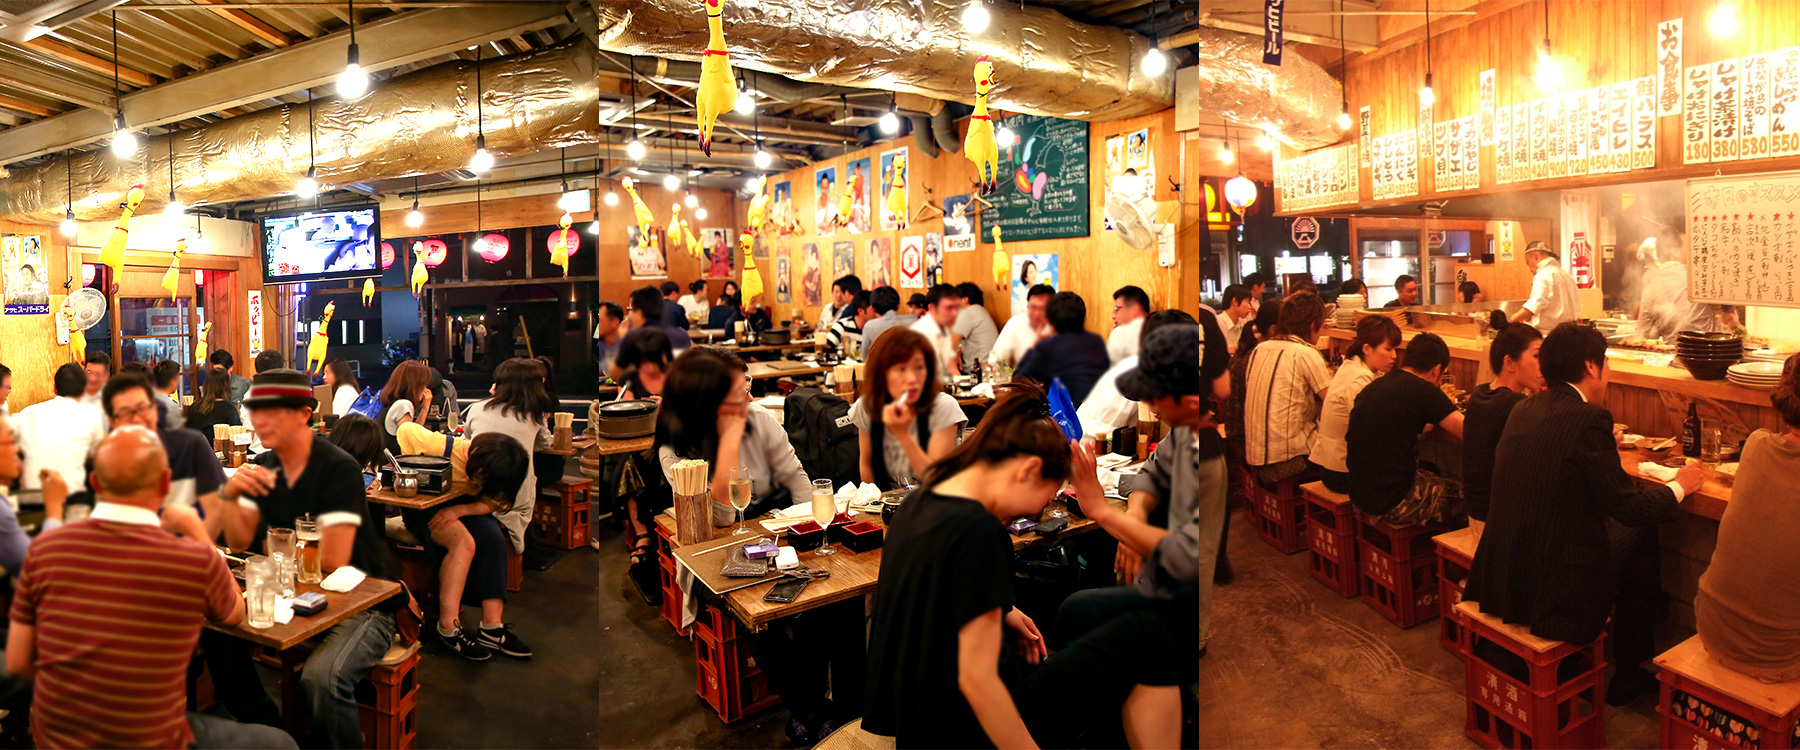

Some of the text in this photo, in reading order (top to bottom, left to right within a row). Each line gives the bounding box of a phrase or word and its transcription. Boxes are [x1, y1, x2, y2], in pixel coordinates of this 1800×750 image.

[1660, 22, 1681, 113] お食事
[1686, 69, 1709, 142] しゃけおにぎり
[1713, 63, 1737, 138] しゃけ茶漬け
[1772, 66, 1786, 133] きしめん
[1611, 88, 1629, 150] エイヒレ
[1636, 77, 1655, 149] 鮭ハラス
[1450, 121, 1461, 173] サザエ
[1686, 142, 1709, 161] 180
[1713, 139, 1737, 158] 380
[1742, 136, 1768, 156] 580
[1772, 132, 1800, 153] 550
[1384, 137, 1393, 182] ししとう
[1395, 136, 1405, 182] にんにく
[1406, 133, 1416, 180] エリンギ
[1568, 158, 1587, 174] 720
[1589, 153, 1608, 169] 450
[1610, 152, 1629, 169] 430
[1633, 150, 1654, 167] 500
[1497, 167, 1512, 182] 620
[1514, 165, 1529, 180] 580
[1532, 163, 1547, 178] 420
[1549, 161, 1566, 176] 900
[1450, 175, 1463, 188] 230
[1464, 173, 1478, 186] 250
[251, 294, 260, 335] ホッピー
[1486, 671, 1518, 702] 清酒
[1480, 685, 1528, 723] 専用通箱
